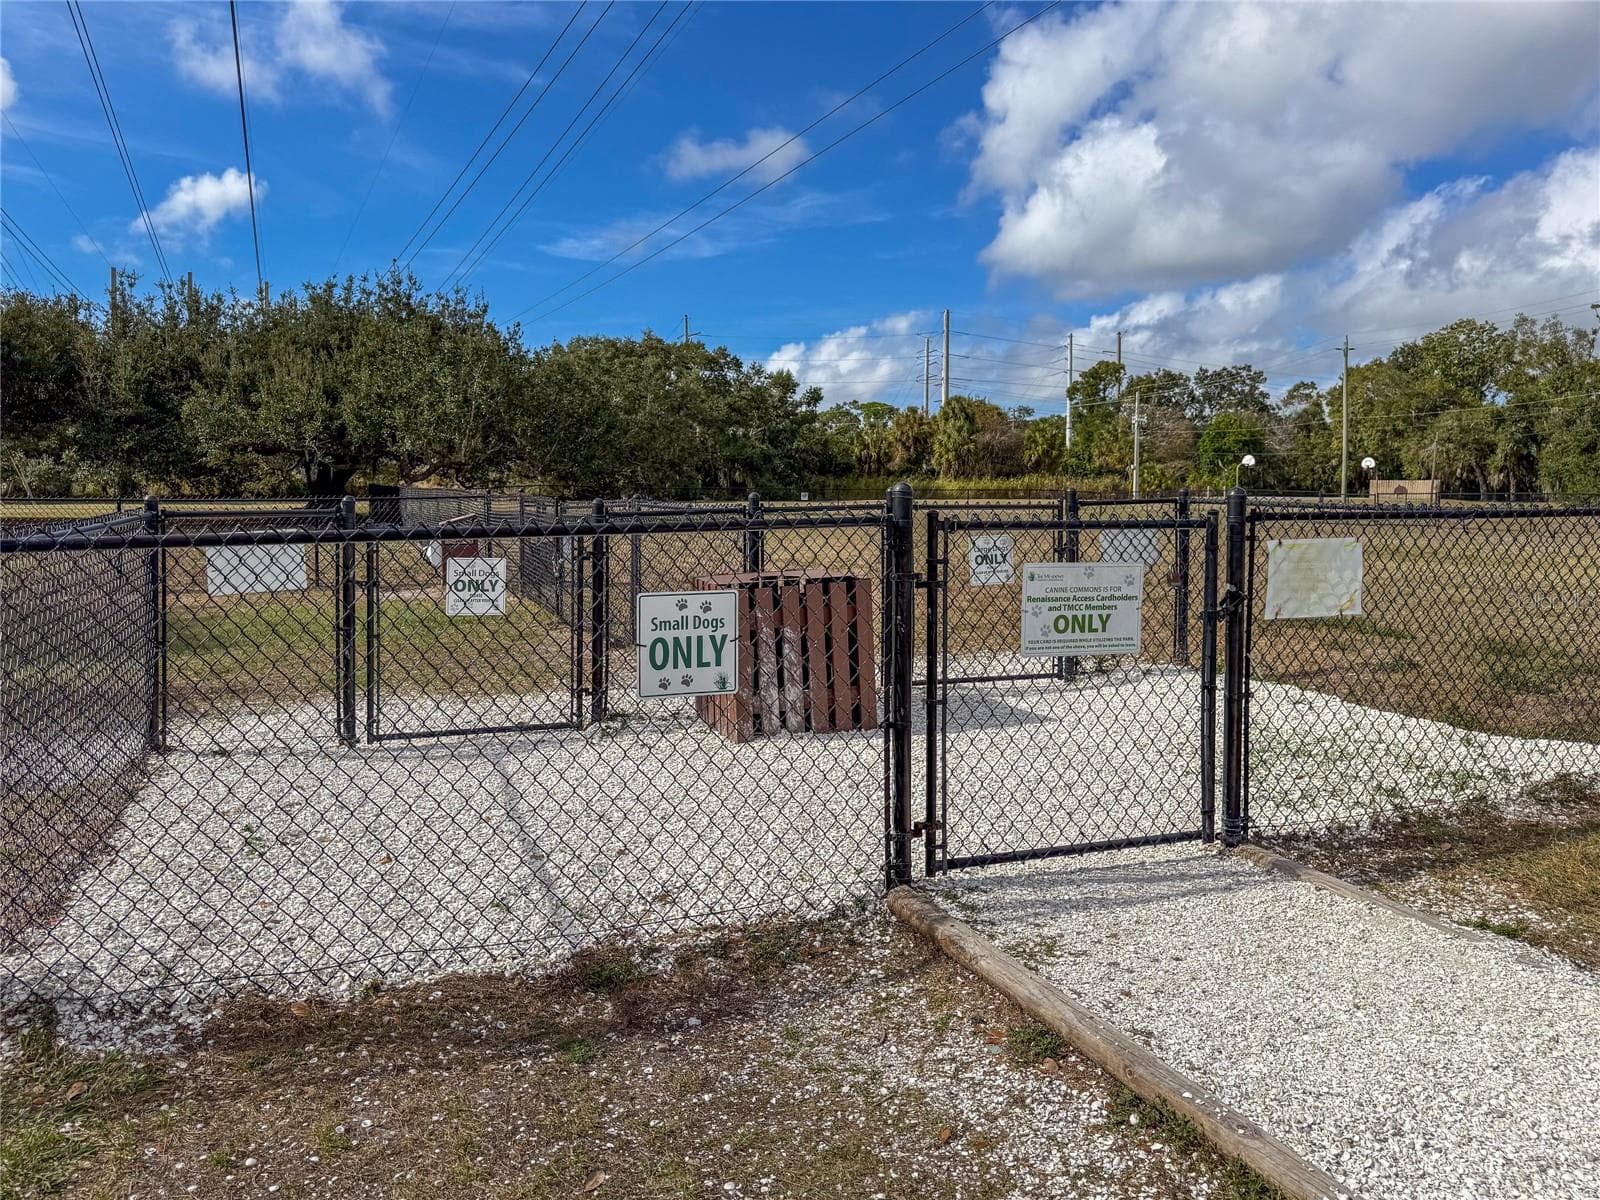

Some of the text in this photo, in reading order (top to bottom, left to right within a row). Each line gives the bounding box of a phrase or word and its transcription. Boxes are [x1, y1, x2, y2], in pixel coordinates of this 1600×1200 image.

[974, 554, 1007, 566] ONLY
[453, 580, 499, 592] ONLY
[650, 615, 725, 632] Small Dogs
[1053, 613, 1111, 634] ONLY
[649, 634, 728, 670] ONLY
